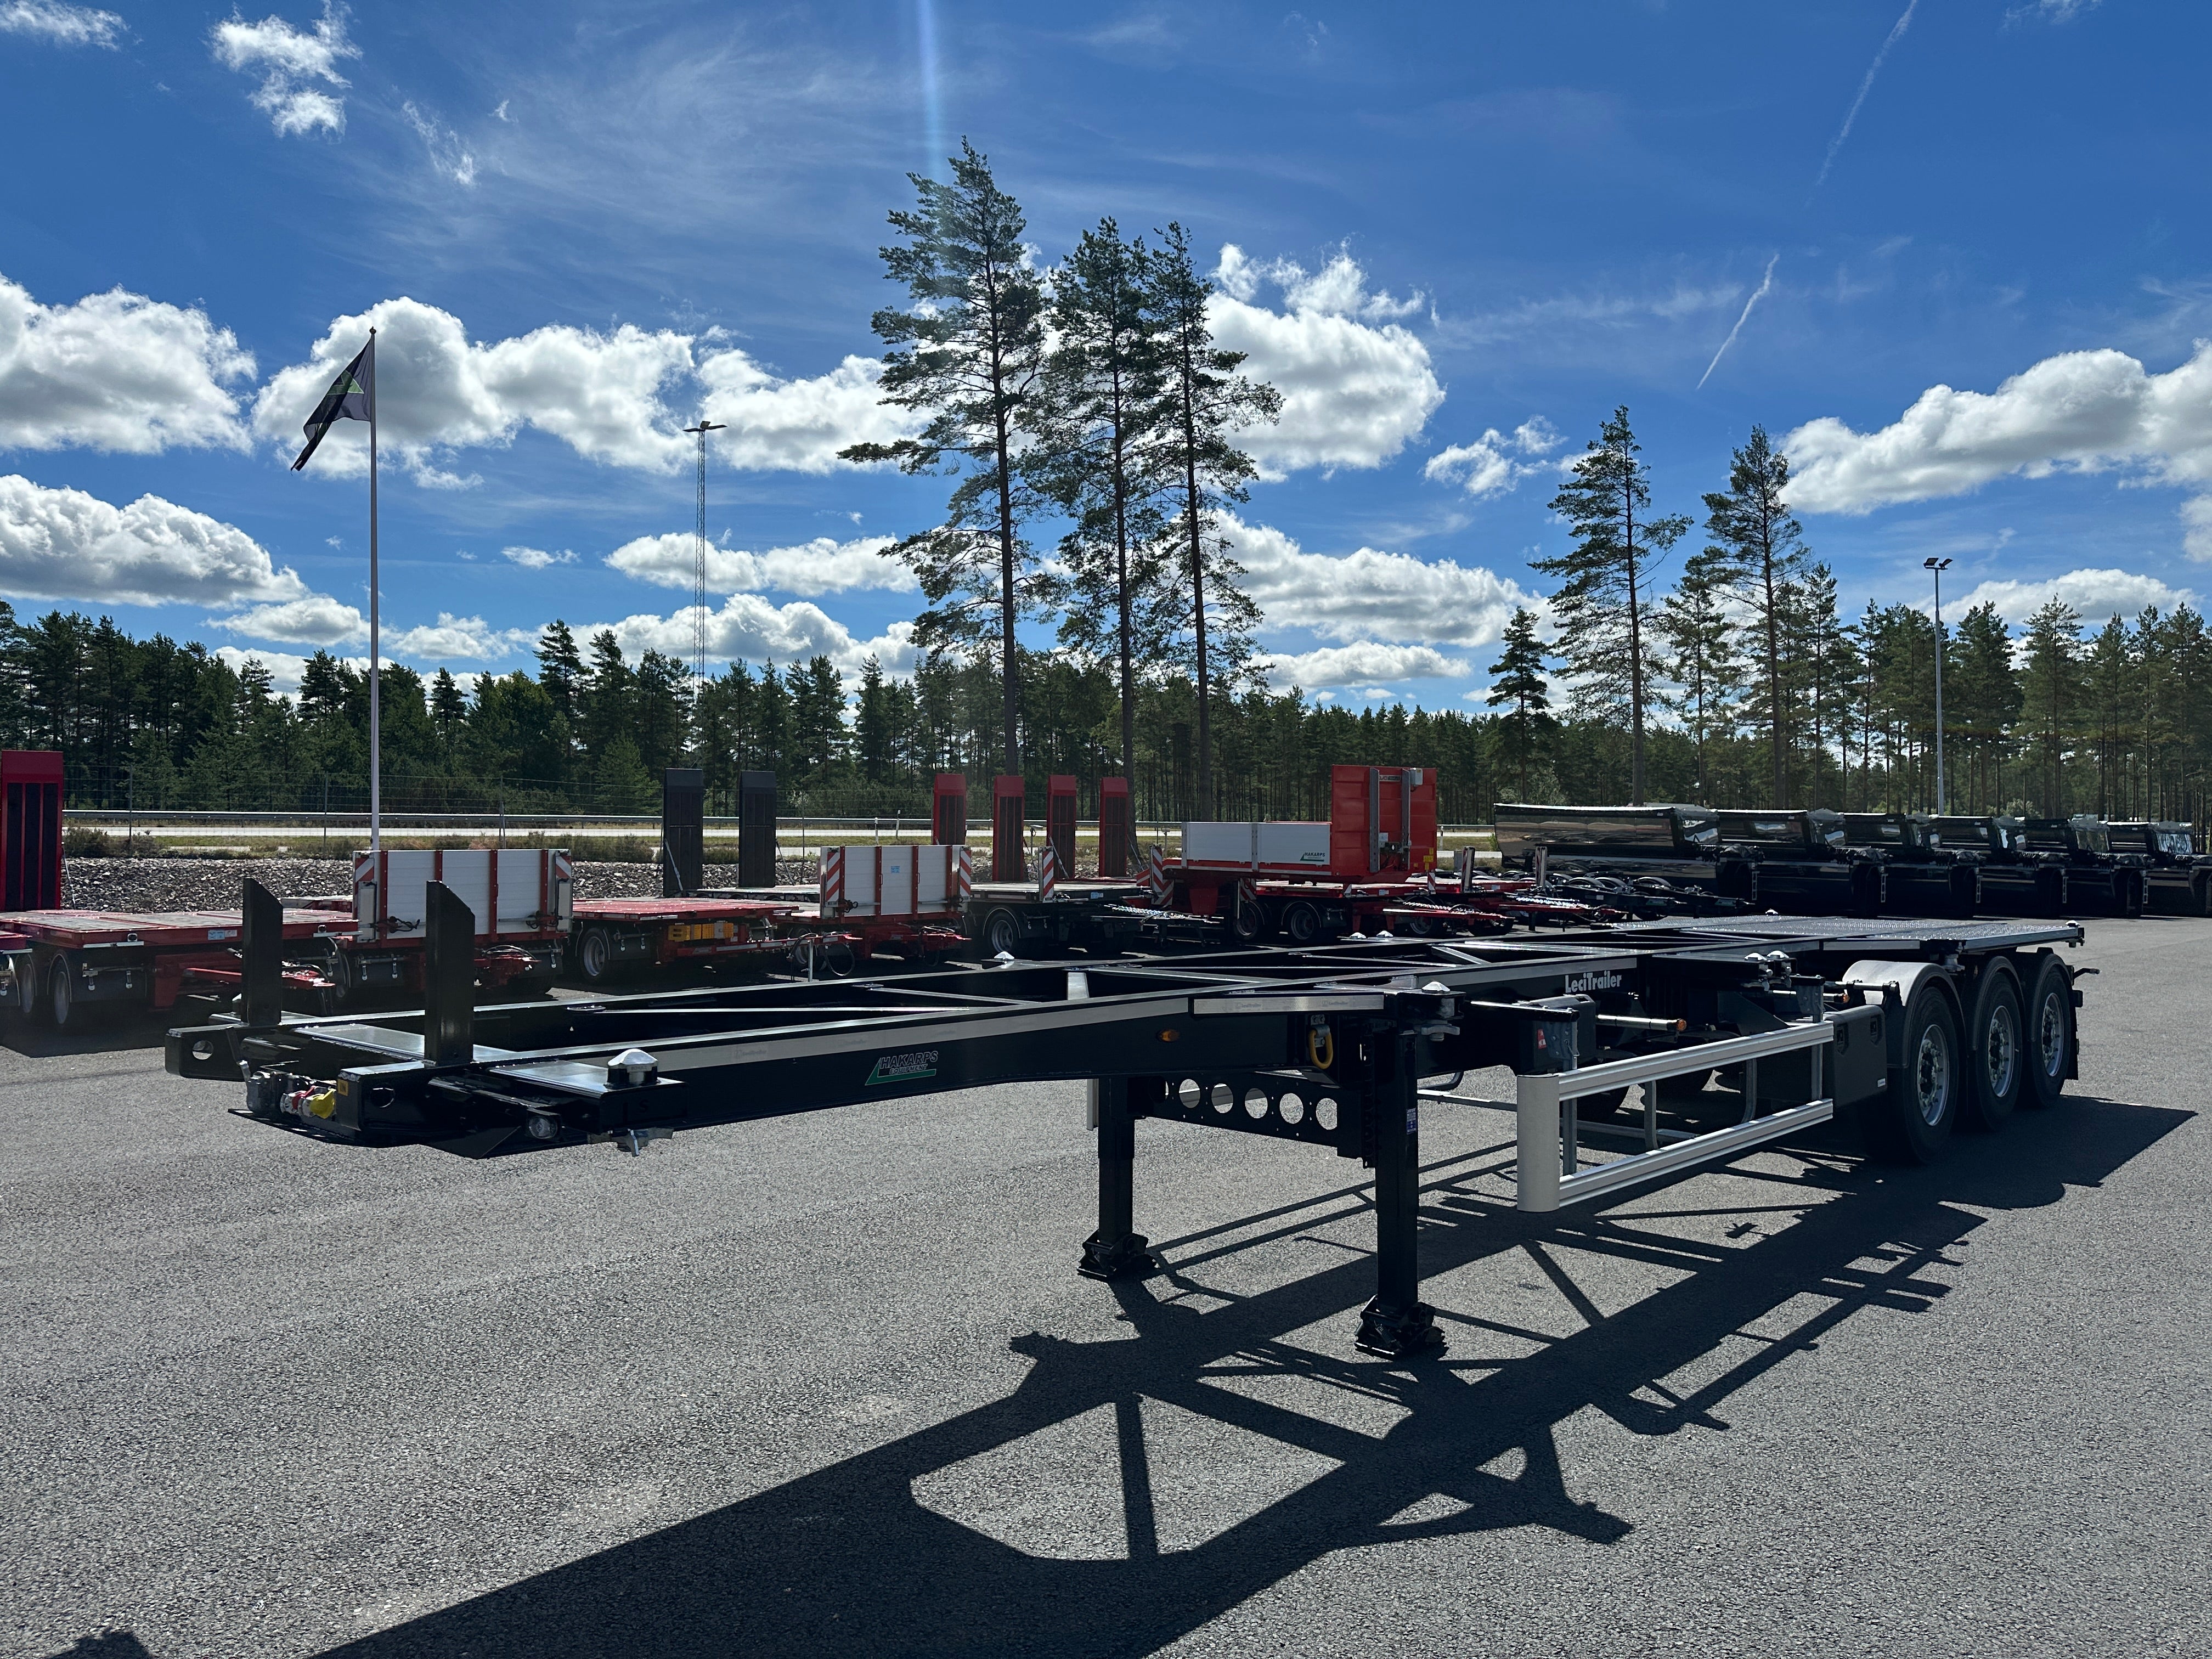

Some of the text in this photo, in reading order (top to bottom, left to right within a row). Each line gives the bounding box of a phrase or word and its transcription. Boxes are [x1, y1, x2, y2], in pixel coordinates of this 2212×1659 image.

[1565, 970, 1622, 993] LeciTrailer
[880, 1051, 938, 1069] HAKARPS
[889, 1063, 928, 1075] EQUIPMENT
